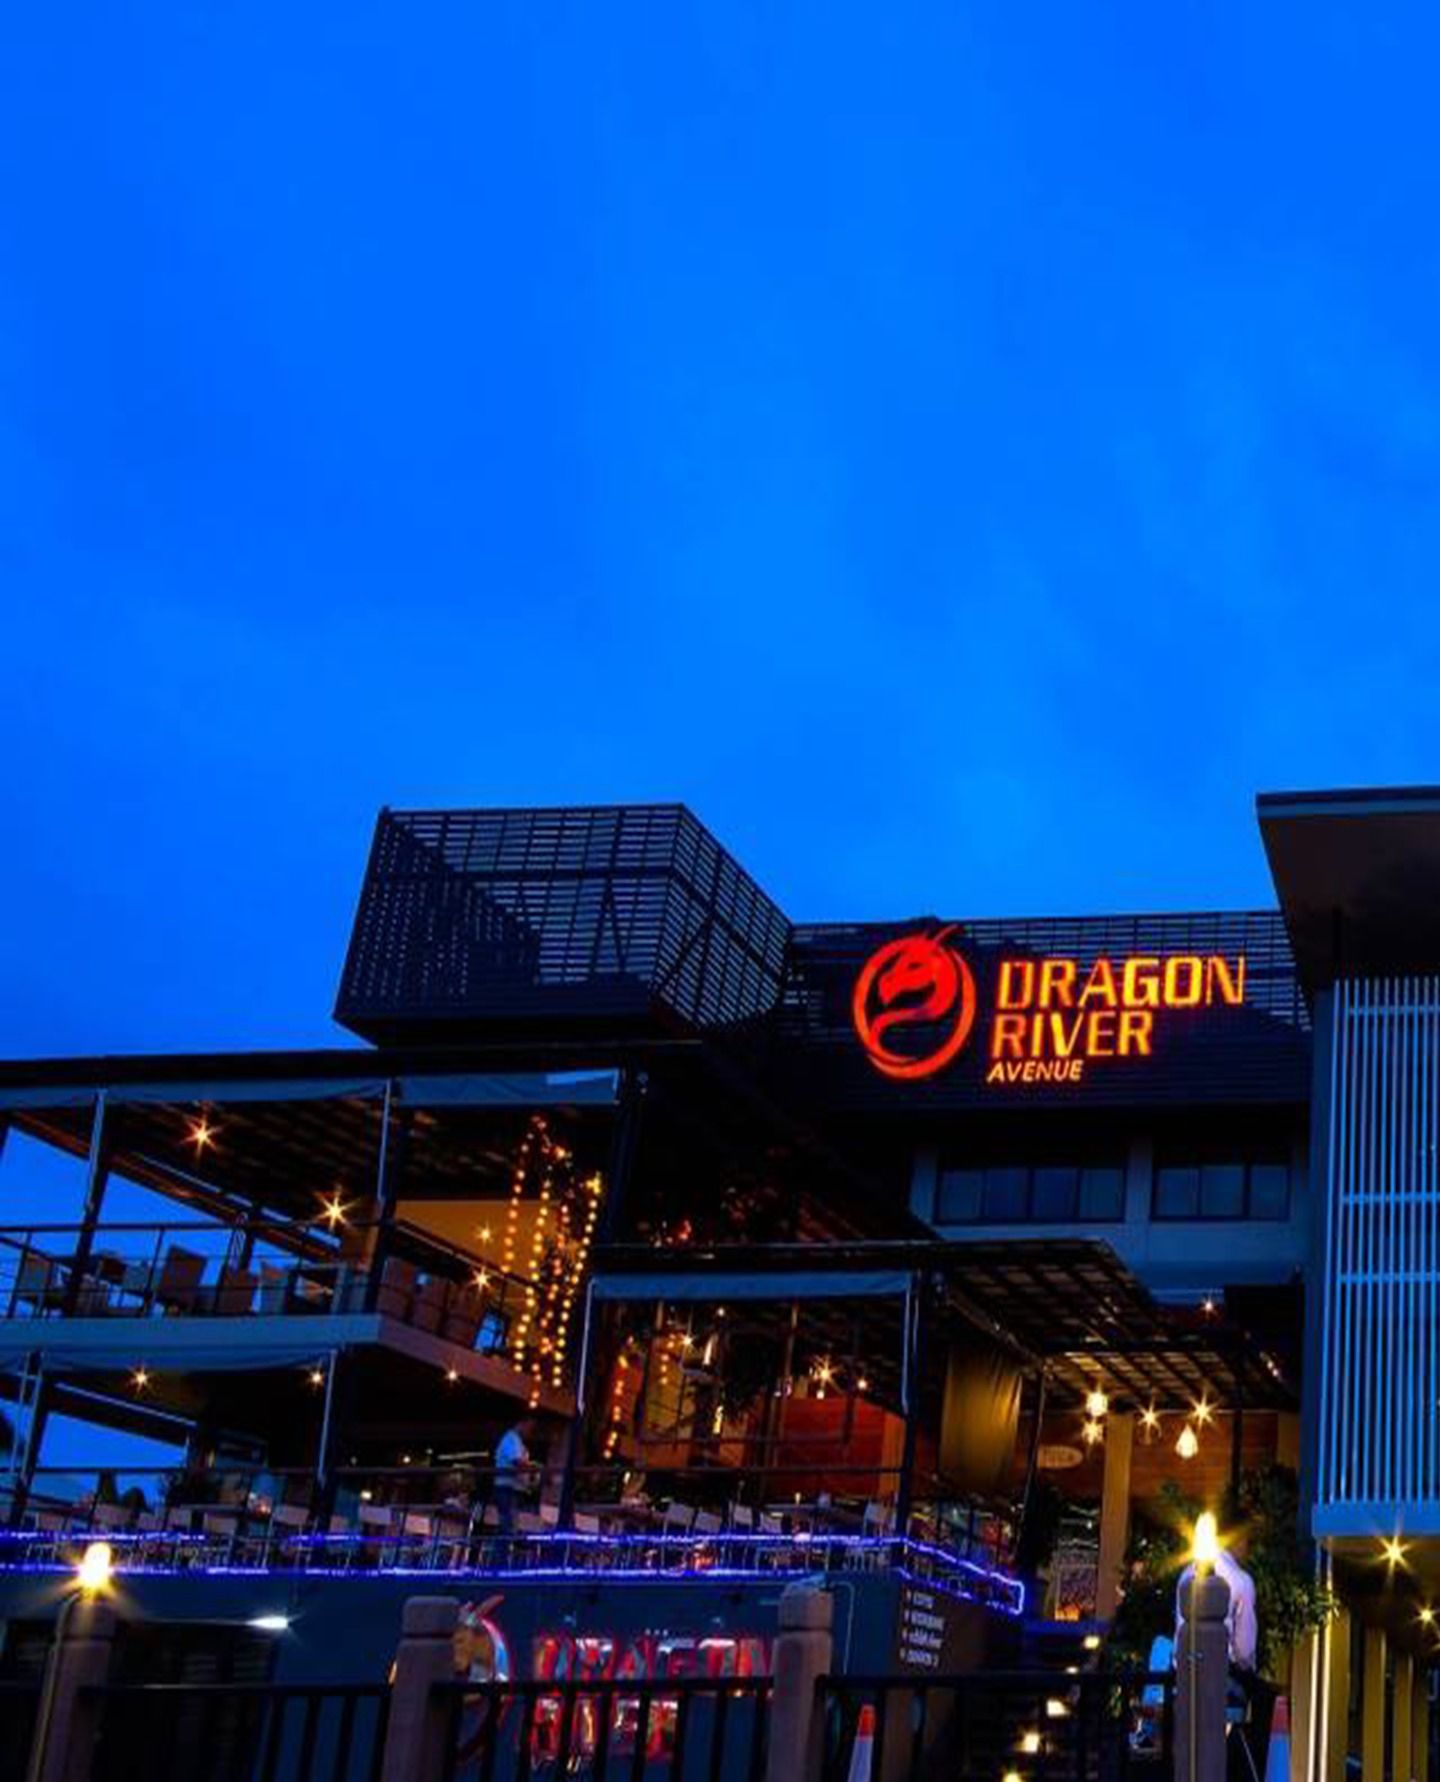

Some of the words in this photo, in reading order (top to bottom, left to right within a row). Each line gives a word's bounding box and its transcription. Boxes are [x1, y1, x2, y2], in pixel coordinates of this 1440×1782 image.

[997, 956, 1246, 1009] DRAGON
[991, 1010, 1153, 1059] RIVER
[986, 1058, 1084, 1083] AVENUE
